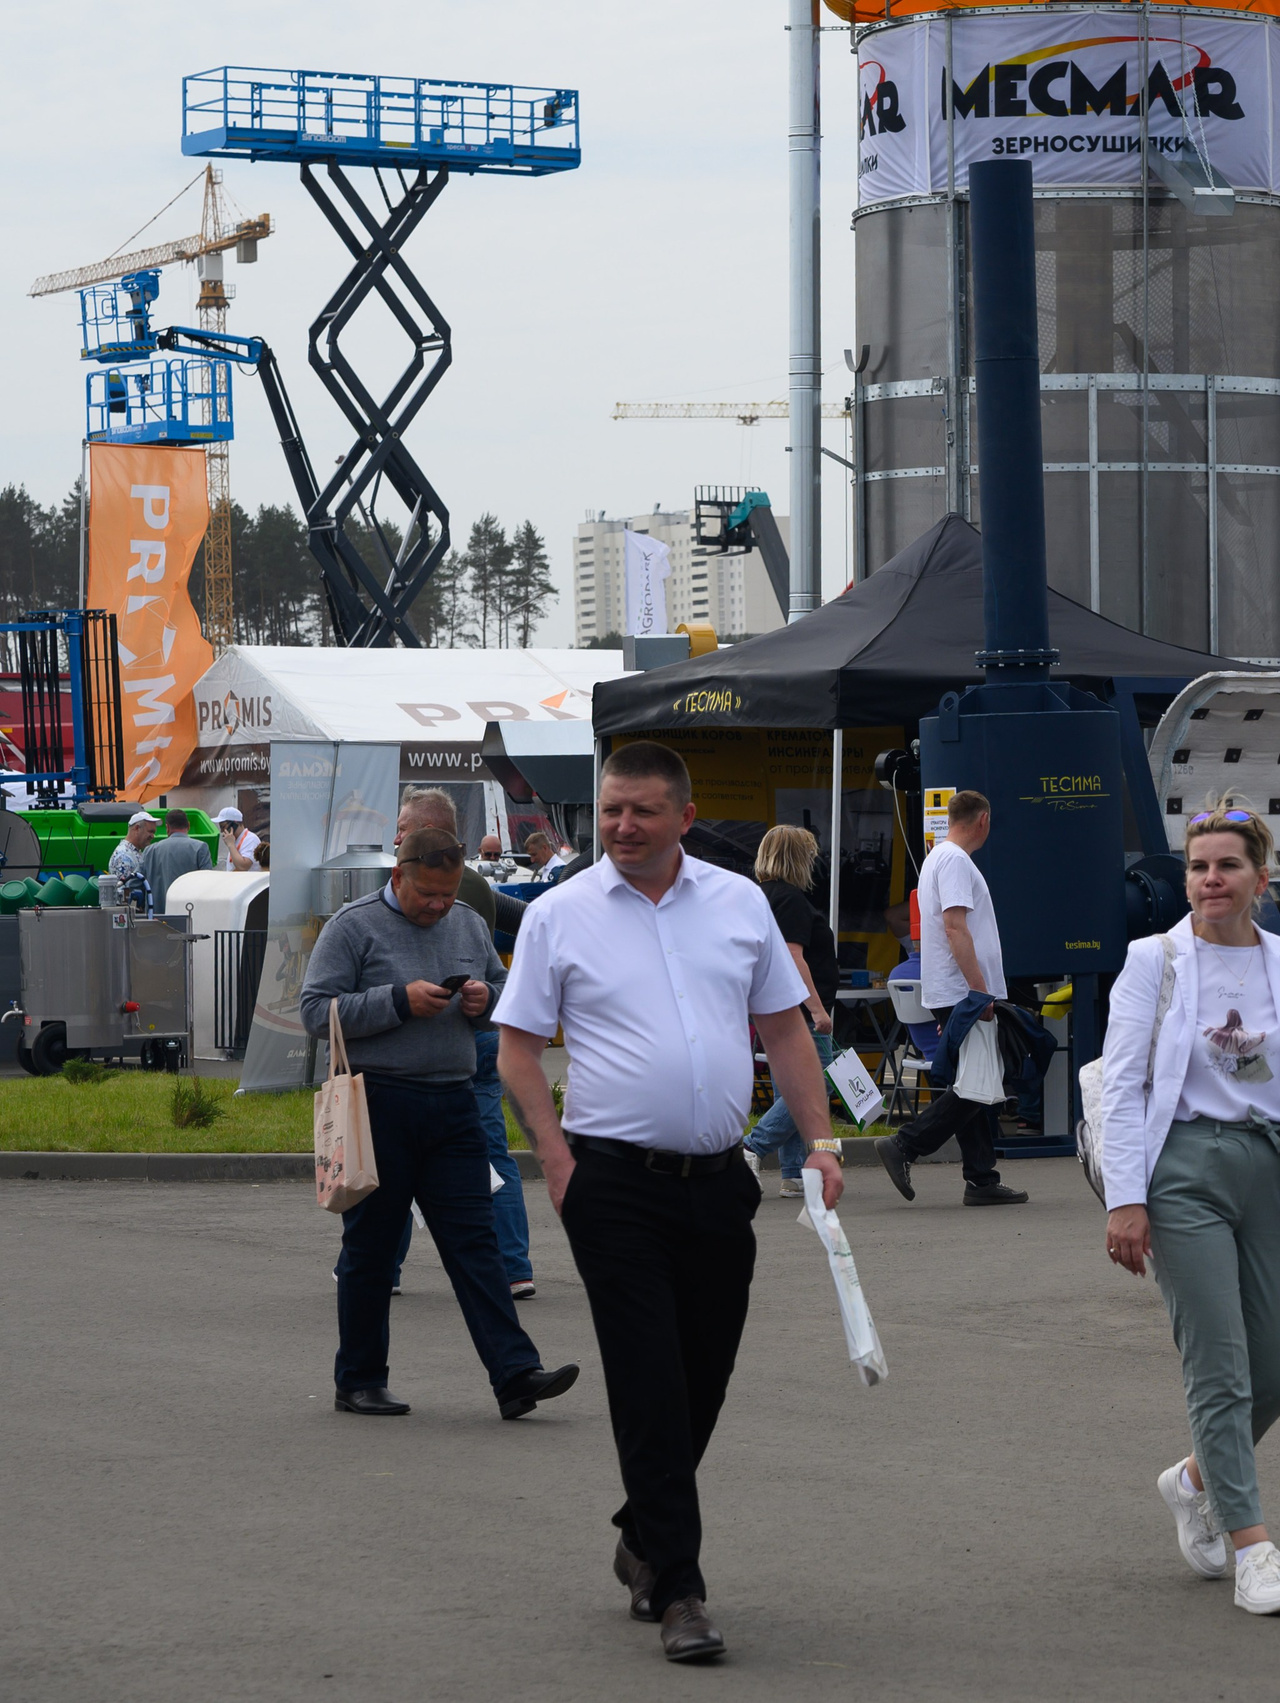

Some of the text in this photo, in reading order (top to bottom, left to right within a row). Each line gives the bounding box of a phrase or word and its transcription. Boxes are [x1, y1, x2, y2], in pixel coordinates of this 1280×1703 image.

[859, 81, 907, 143] AR
[942, 61, 1245, 120] MECMAR
[1040, 775, 1101, 793] ТЕСИМА
